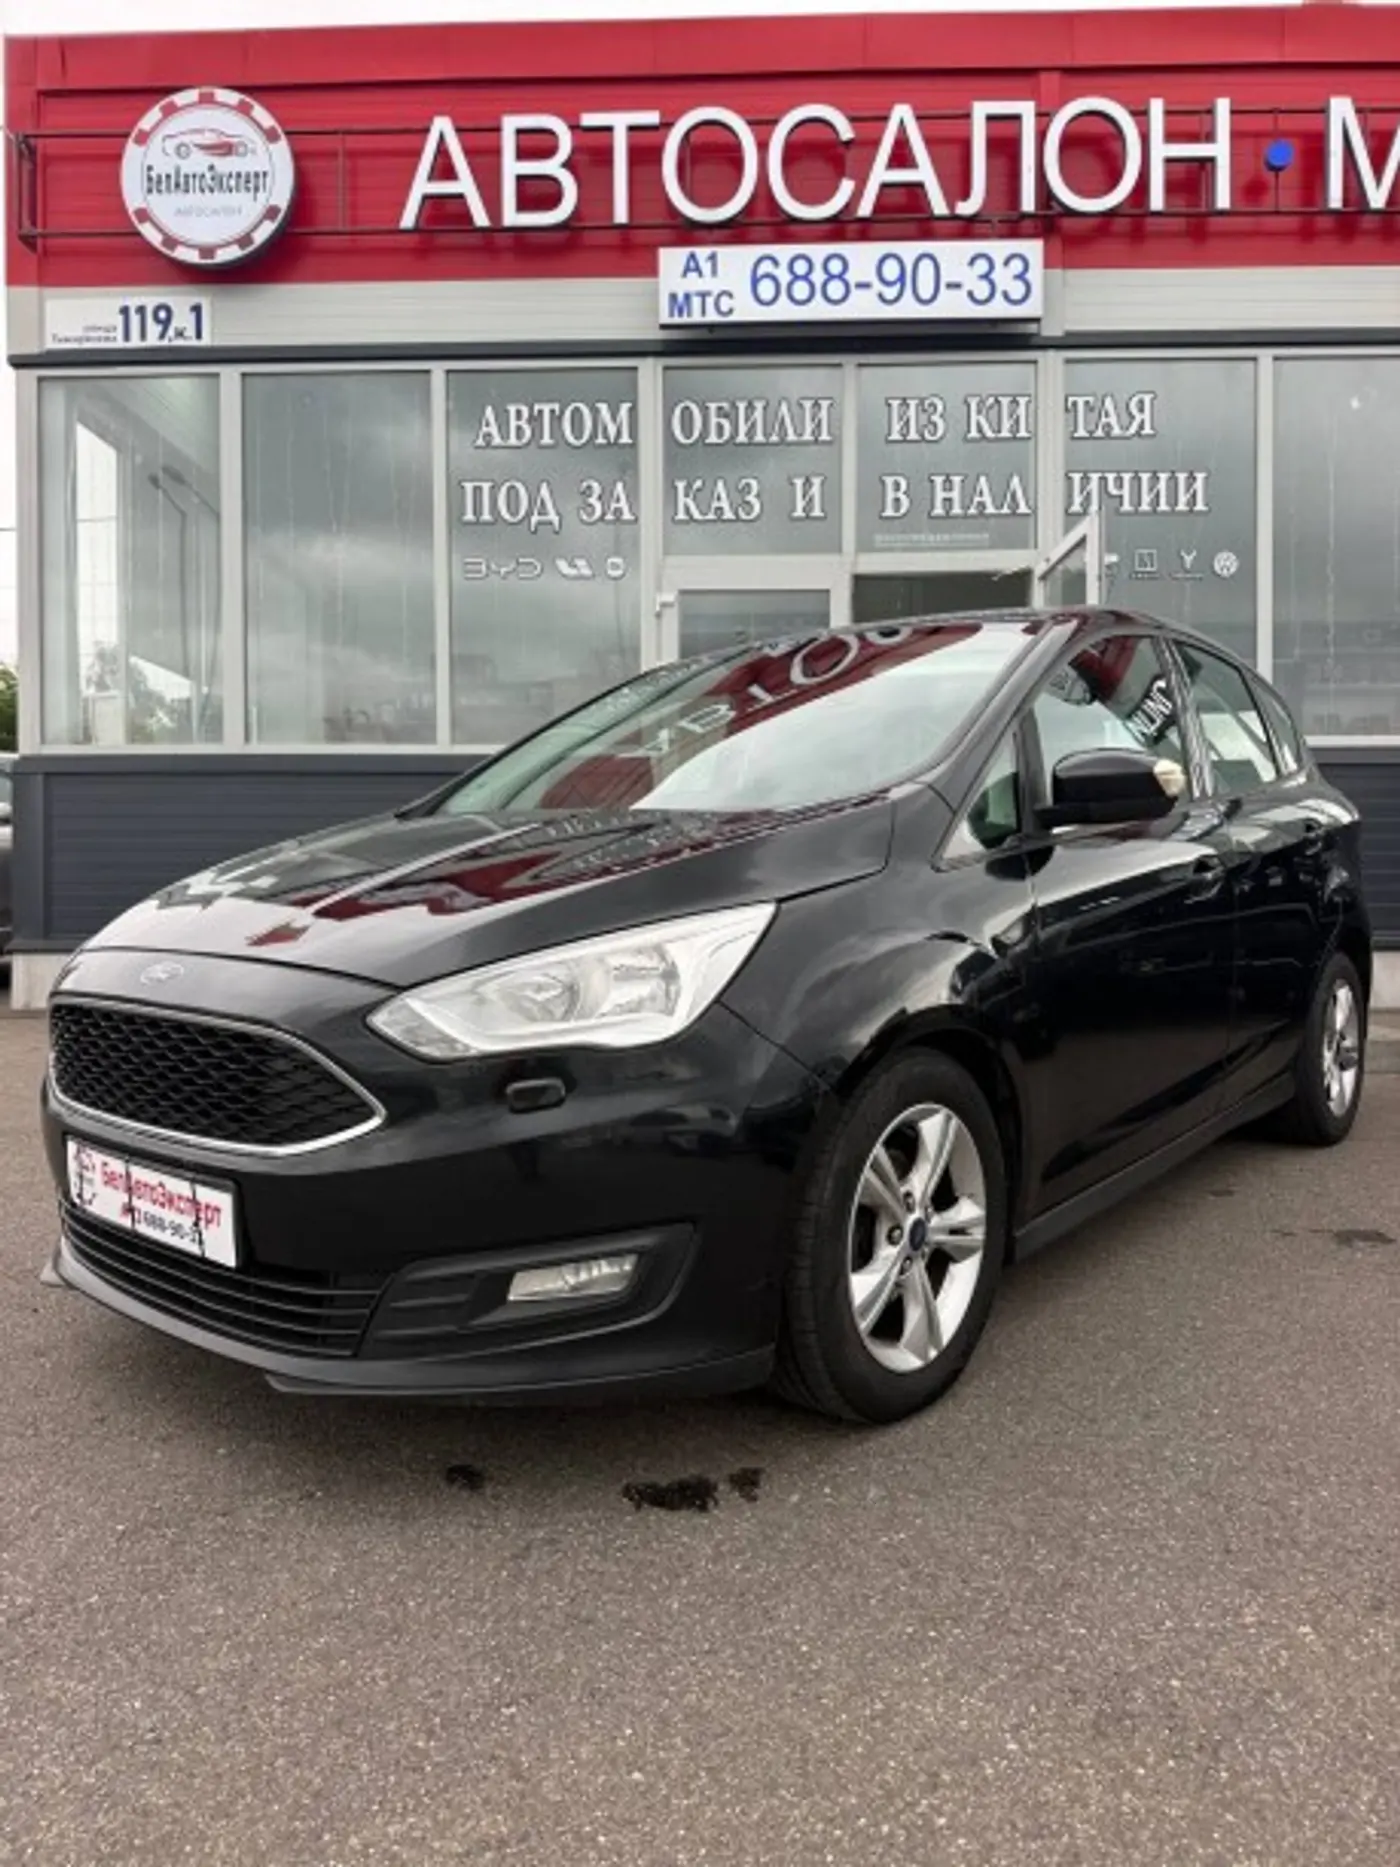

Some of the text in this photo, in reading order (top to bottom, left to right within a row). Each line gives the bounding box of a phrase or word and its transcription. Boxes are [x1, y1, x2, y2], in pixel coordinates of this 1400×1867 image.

[146, 163, 268, 202] БелАвтоЭксперт
[400, 97, 1231, 229] АВТОСАЛОН
[668, 290, 734, 318] МТС
[750, 252, 1033, 308] 688-90-33
[886, 395, 946, 441] ИЗ
[461, 480, 561, 533] ПОД
[791, 475, 825, 519] И
[880, 474, 911, 519] В
